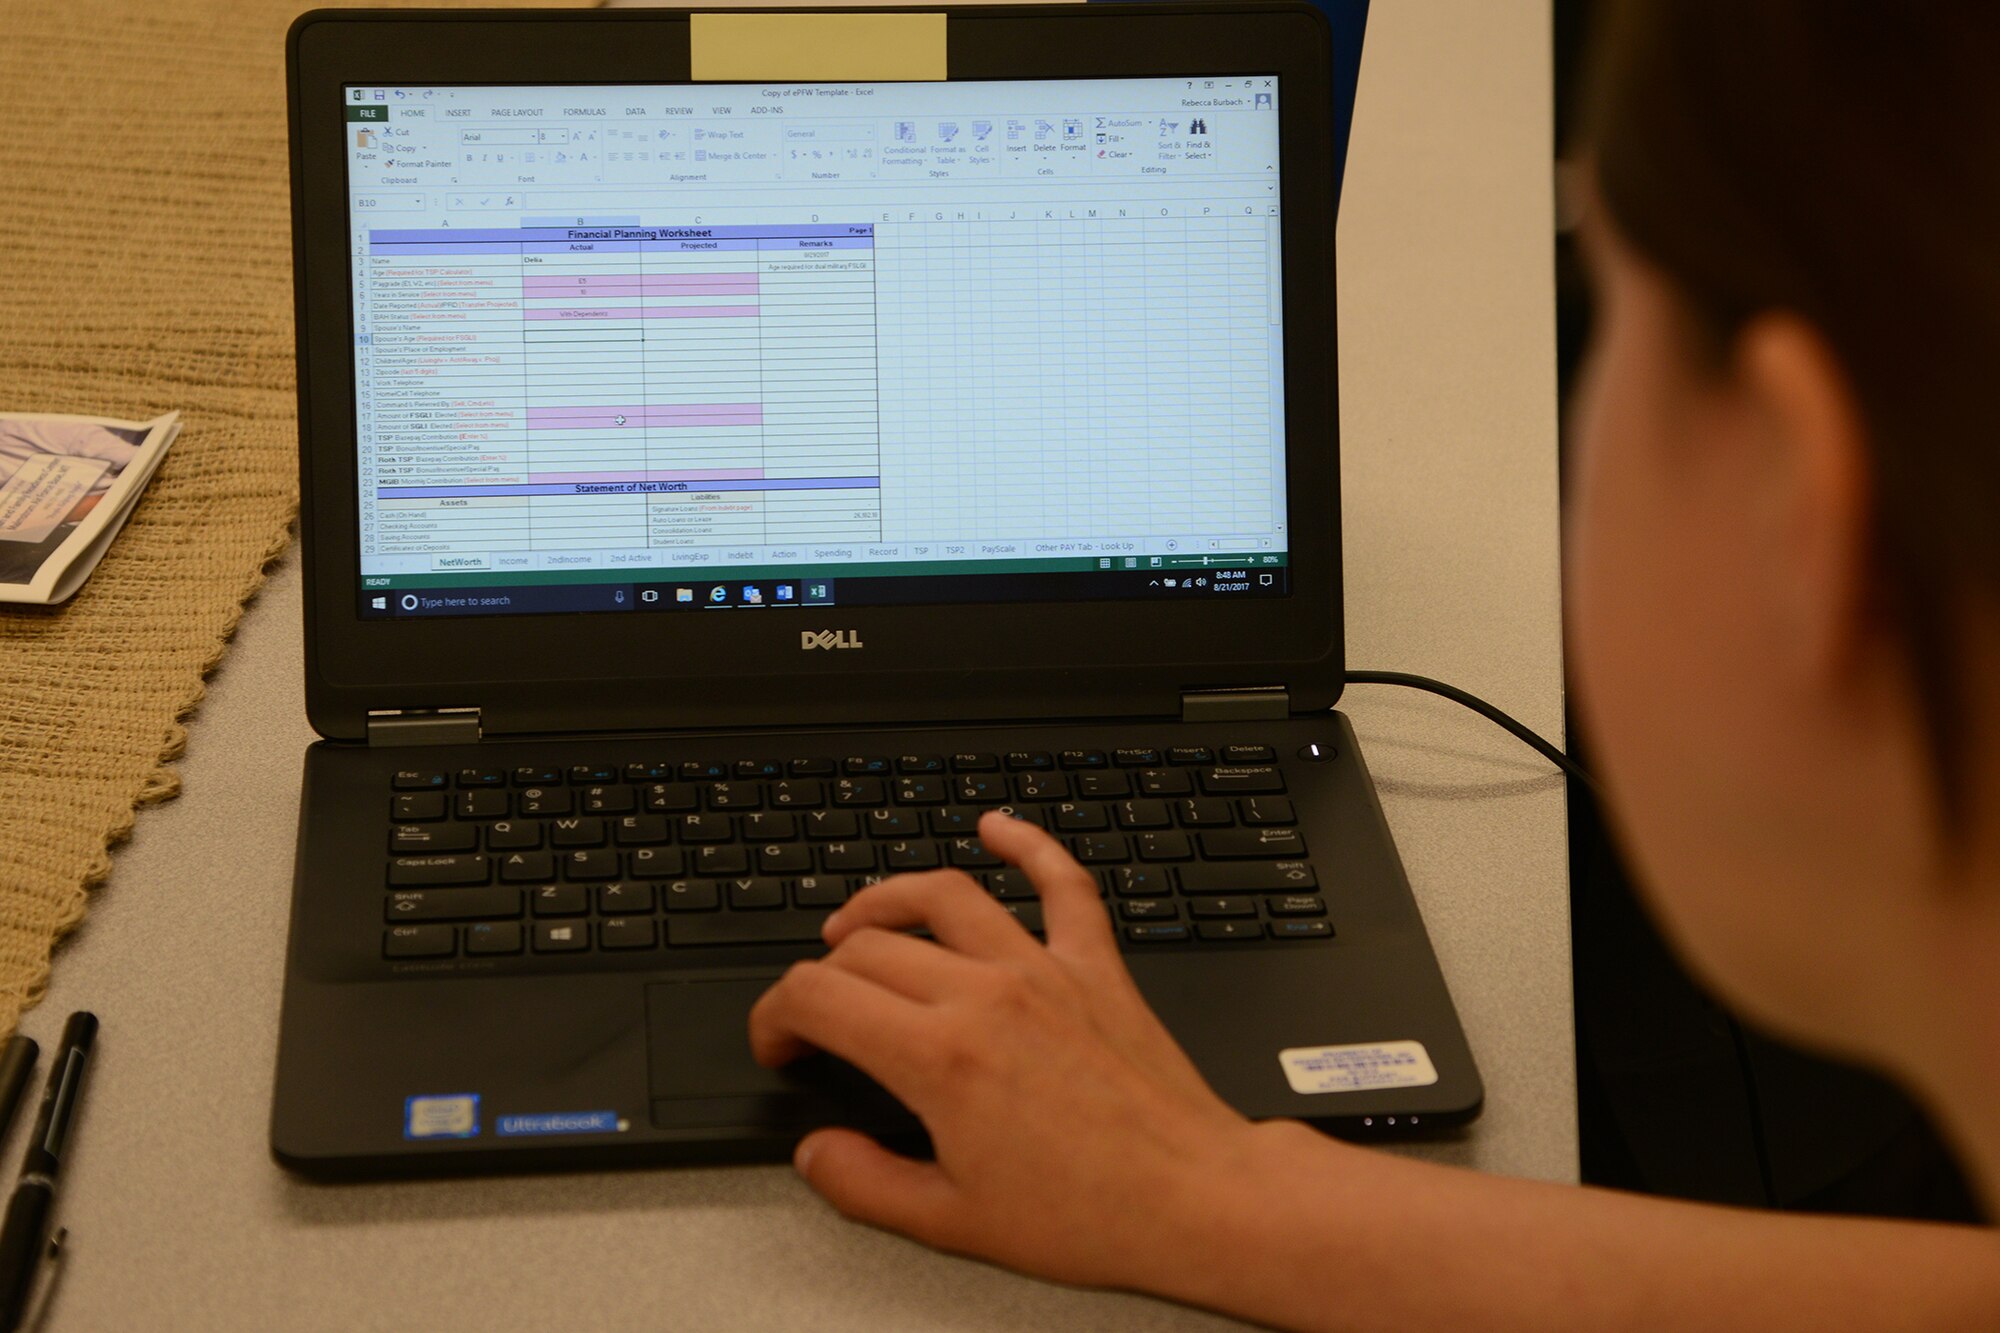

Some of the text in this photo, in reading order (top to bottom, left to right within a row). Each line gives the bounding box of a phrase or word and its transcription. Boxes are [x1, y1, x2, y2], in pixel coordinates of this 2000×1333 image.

[762, 89, 781, 98] Copy
[816, 88, 848, 97] Template
[1214, 98, 1243, 106] Burbach
[360, 110, 376, 118] FILE
[491, 108, 511, 116] PAGE
[751, 106, 784, 114] ADD-INS
[396, 128, 409, 136] Cut
[708, 132, 727, 140] Wrap
[788, 130, 814, 138] General
[464, 133, 481, 142] Arial
[396, 144, 416, 153] Copy
[884, 146, 926, 154] Conditional
[930, 146, 957, 154] Format
[708, 152, 732, 161] Merge
[742, 152, 766, 160] Center
[936, 156, 956, 164] Table
[970, 156, 990, 164] Styles
[397, 160, 452, 168] Format Painter
[883, 157, 923, 166] Formatting
[670, 174, 706, 182] Alignment
[812, 172, 840, 180] Number
[929, 170, 949, 178] Styles
[381, 176, 417, 184] Clipboard
[359, 199, 376, 207] B10
[568, 228, 712, 240] Financial Planning Worksheet
[680, 242, 718, 250] Projected
[576, 482, 688, 493] Statement of Net Worth
[982, 545, 1016, 554] PayScale
[1122, 542, 1134, 551] Up
[772, 550, 797, 558] Action
[814, 549, 852, 558] Spending
[870, 548, 898, 556] Record
[611, 554, 652, 562] 2nd Active
[672, 552, 709, 562] LivingExp
[440, 558, 482, 566] NetWorth
[1216, 570, 1246, 579] 8:48 AM
[1214, 583, 1250, 592] 8/21/2017
[421, 596, 510, 608] Type here to search
[801, 629, 863, 650] DELL
[1173, 746, 1204, 754] Insert
[1214, 766, 1272, 775] Backspace
[1062, 804, 1074, 814] P
[750, 814, 763, 822] T
[812, 812, 827, 821] Y
[874, 810, 888, 820] U
[557, 820, 578, 829] W
[624, 818, 636, 828] E
[687, 816, 700, 824] R
[494, 822, 511, 832] Q
[1262, 829, 1292, 837] Enter
[703, 848, 715, 857] F
[765, 846, 780, 856] G
[830, 844, 845, 854] H
[508, 855, 524, 864] A
[574, 852, 588, 862] S
[638, 850, 654, 860] D
[396, 858, 456, 866] Caps Lock
[672, 882, 686, 893] C
[736, 880, 753, 890] V
[802, 878, 816, 888] B
[542, 887, 557, 897] Z
[607, 884, 622, 895] X
[504, 1116, 604, 1132] Ultrabook
